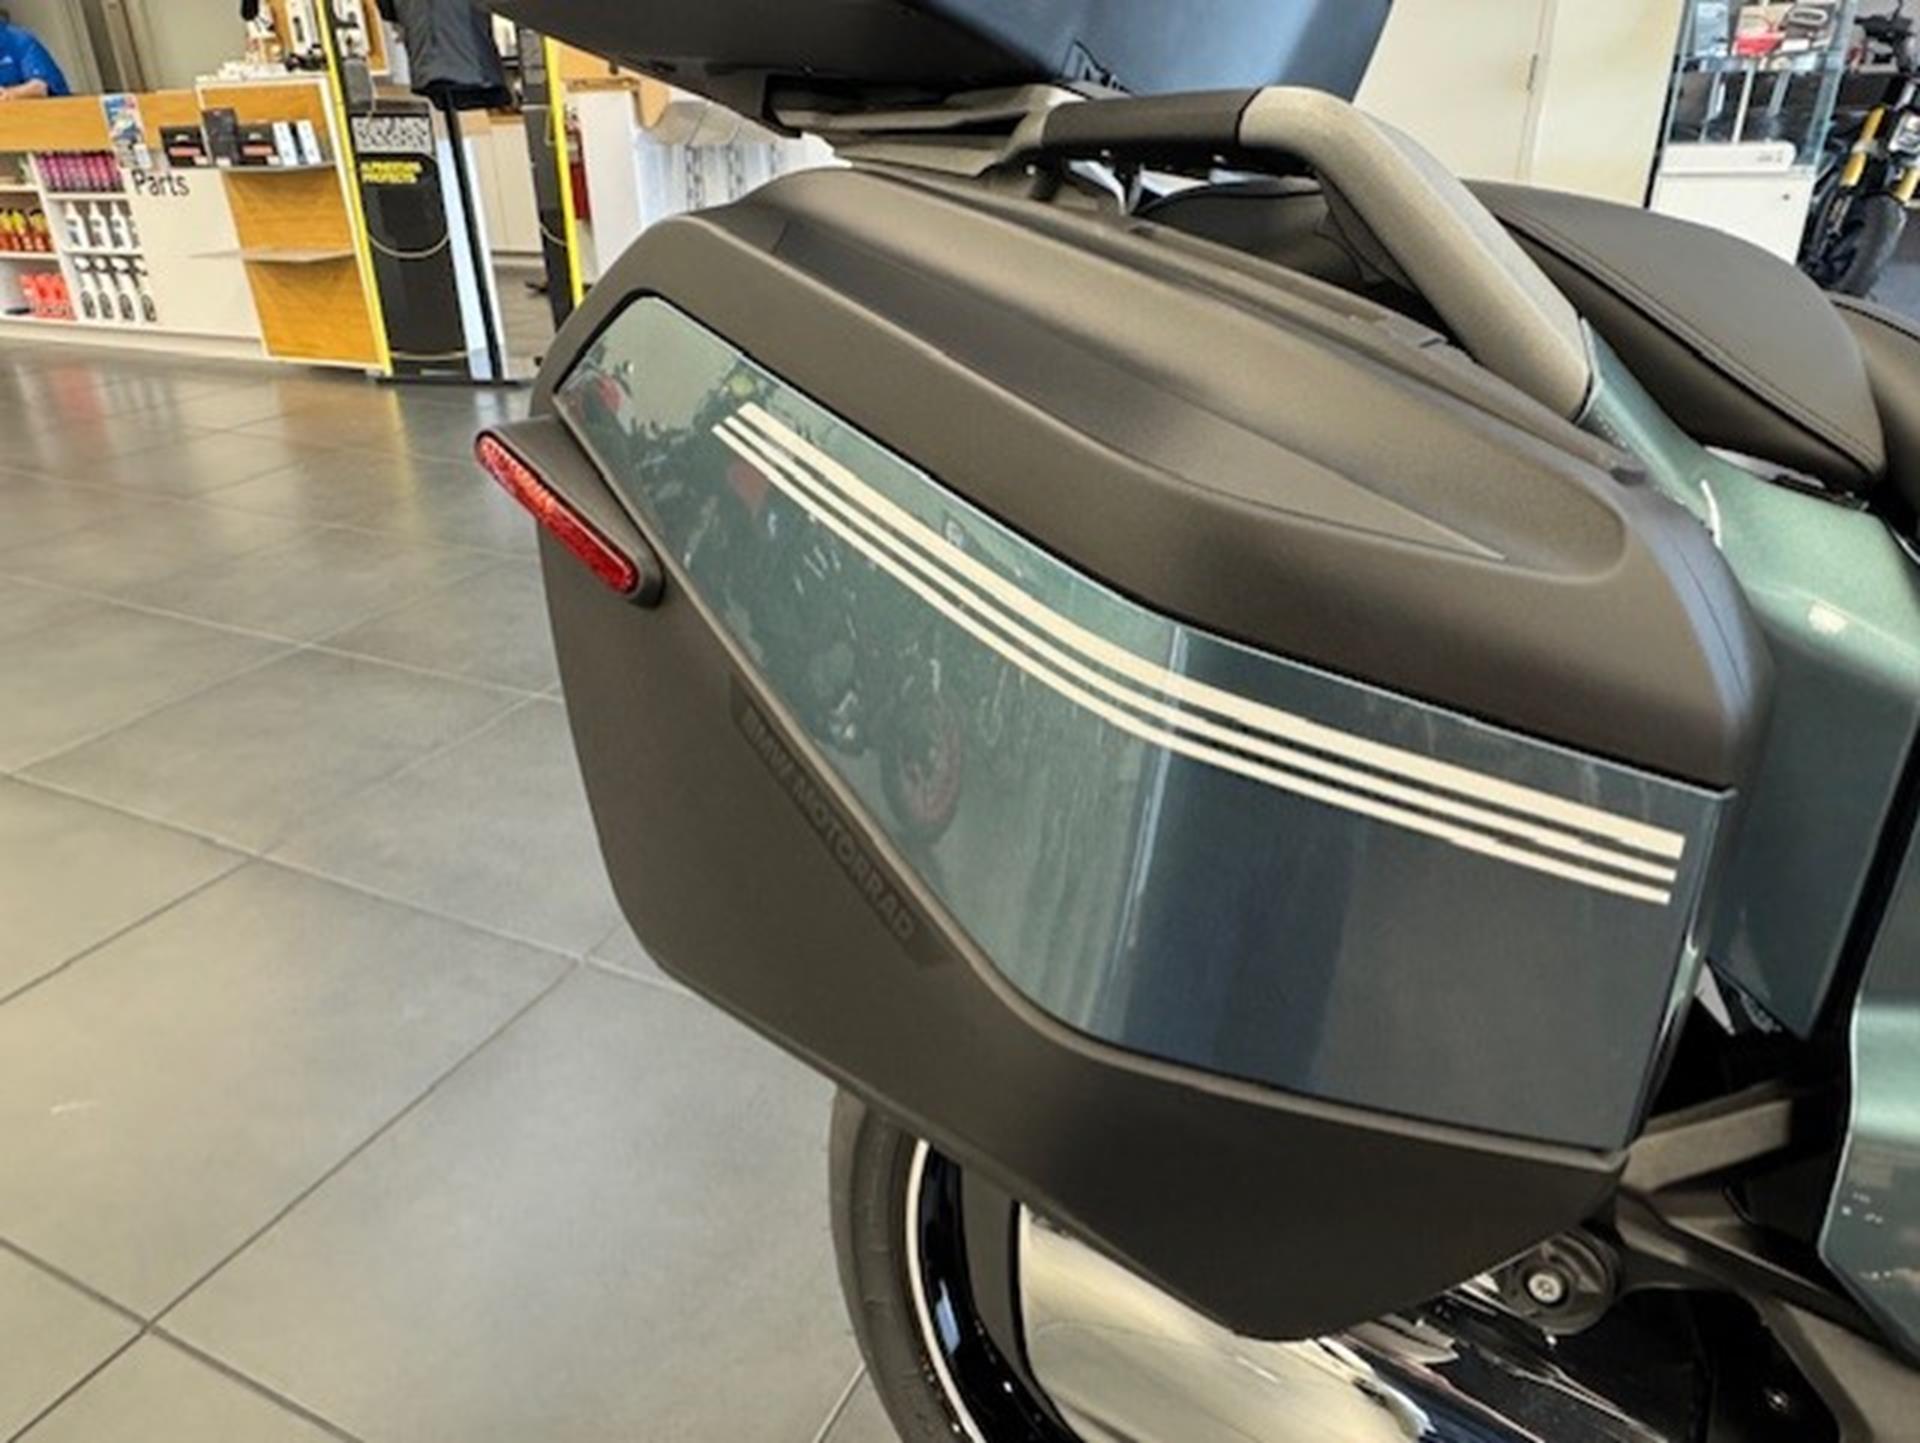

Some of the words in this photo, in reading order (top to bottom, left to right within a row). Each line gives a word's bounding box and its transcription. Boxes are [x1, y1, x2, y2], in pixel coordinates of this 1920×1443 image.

[131, 169, 190, 197] Parts
[738, 706, 797, 776] BMW
[788, 775, 915, 940] MOTORRAD
